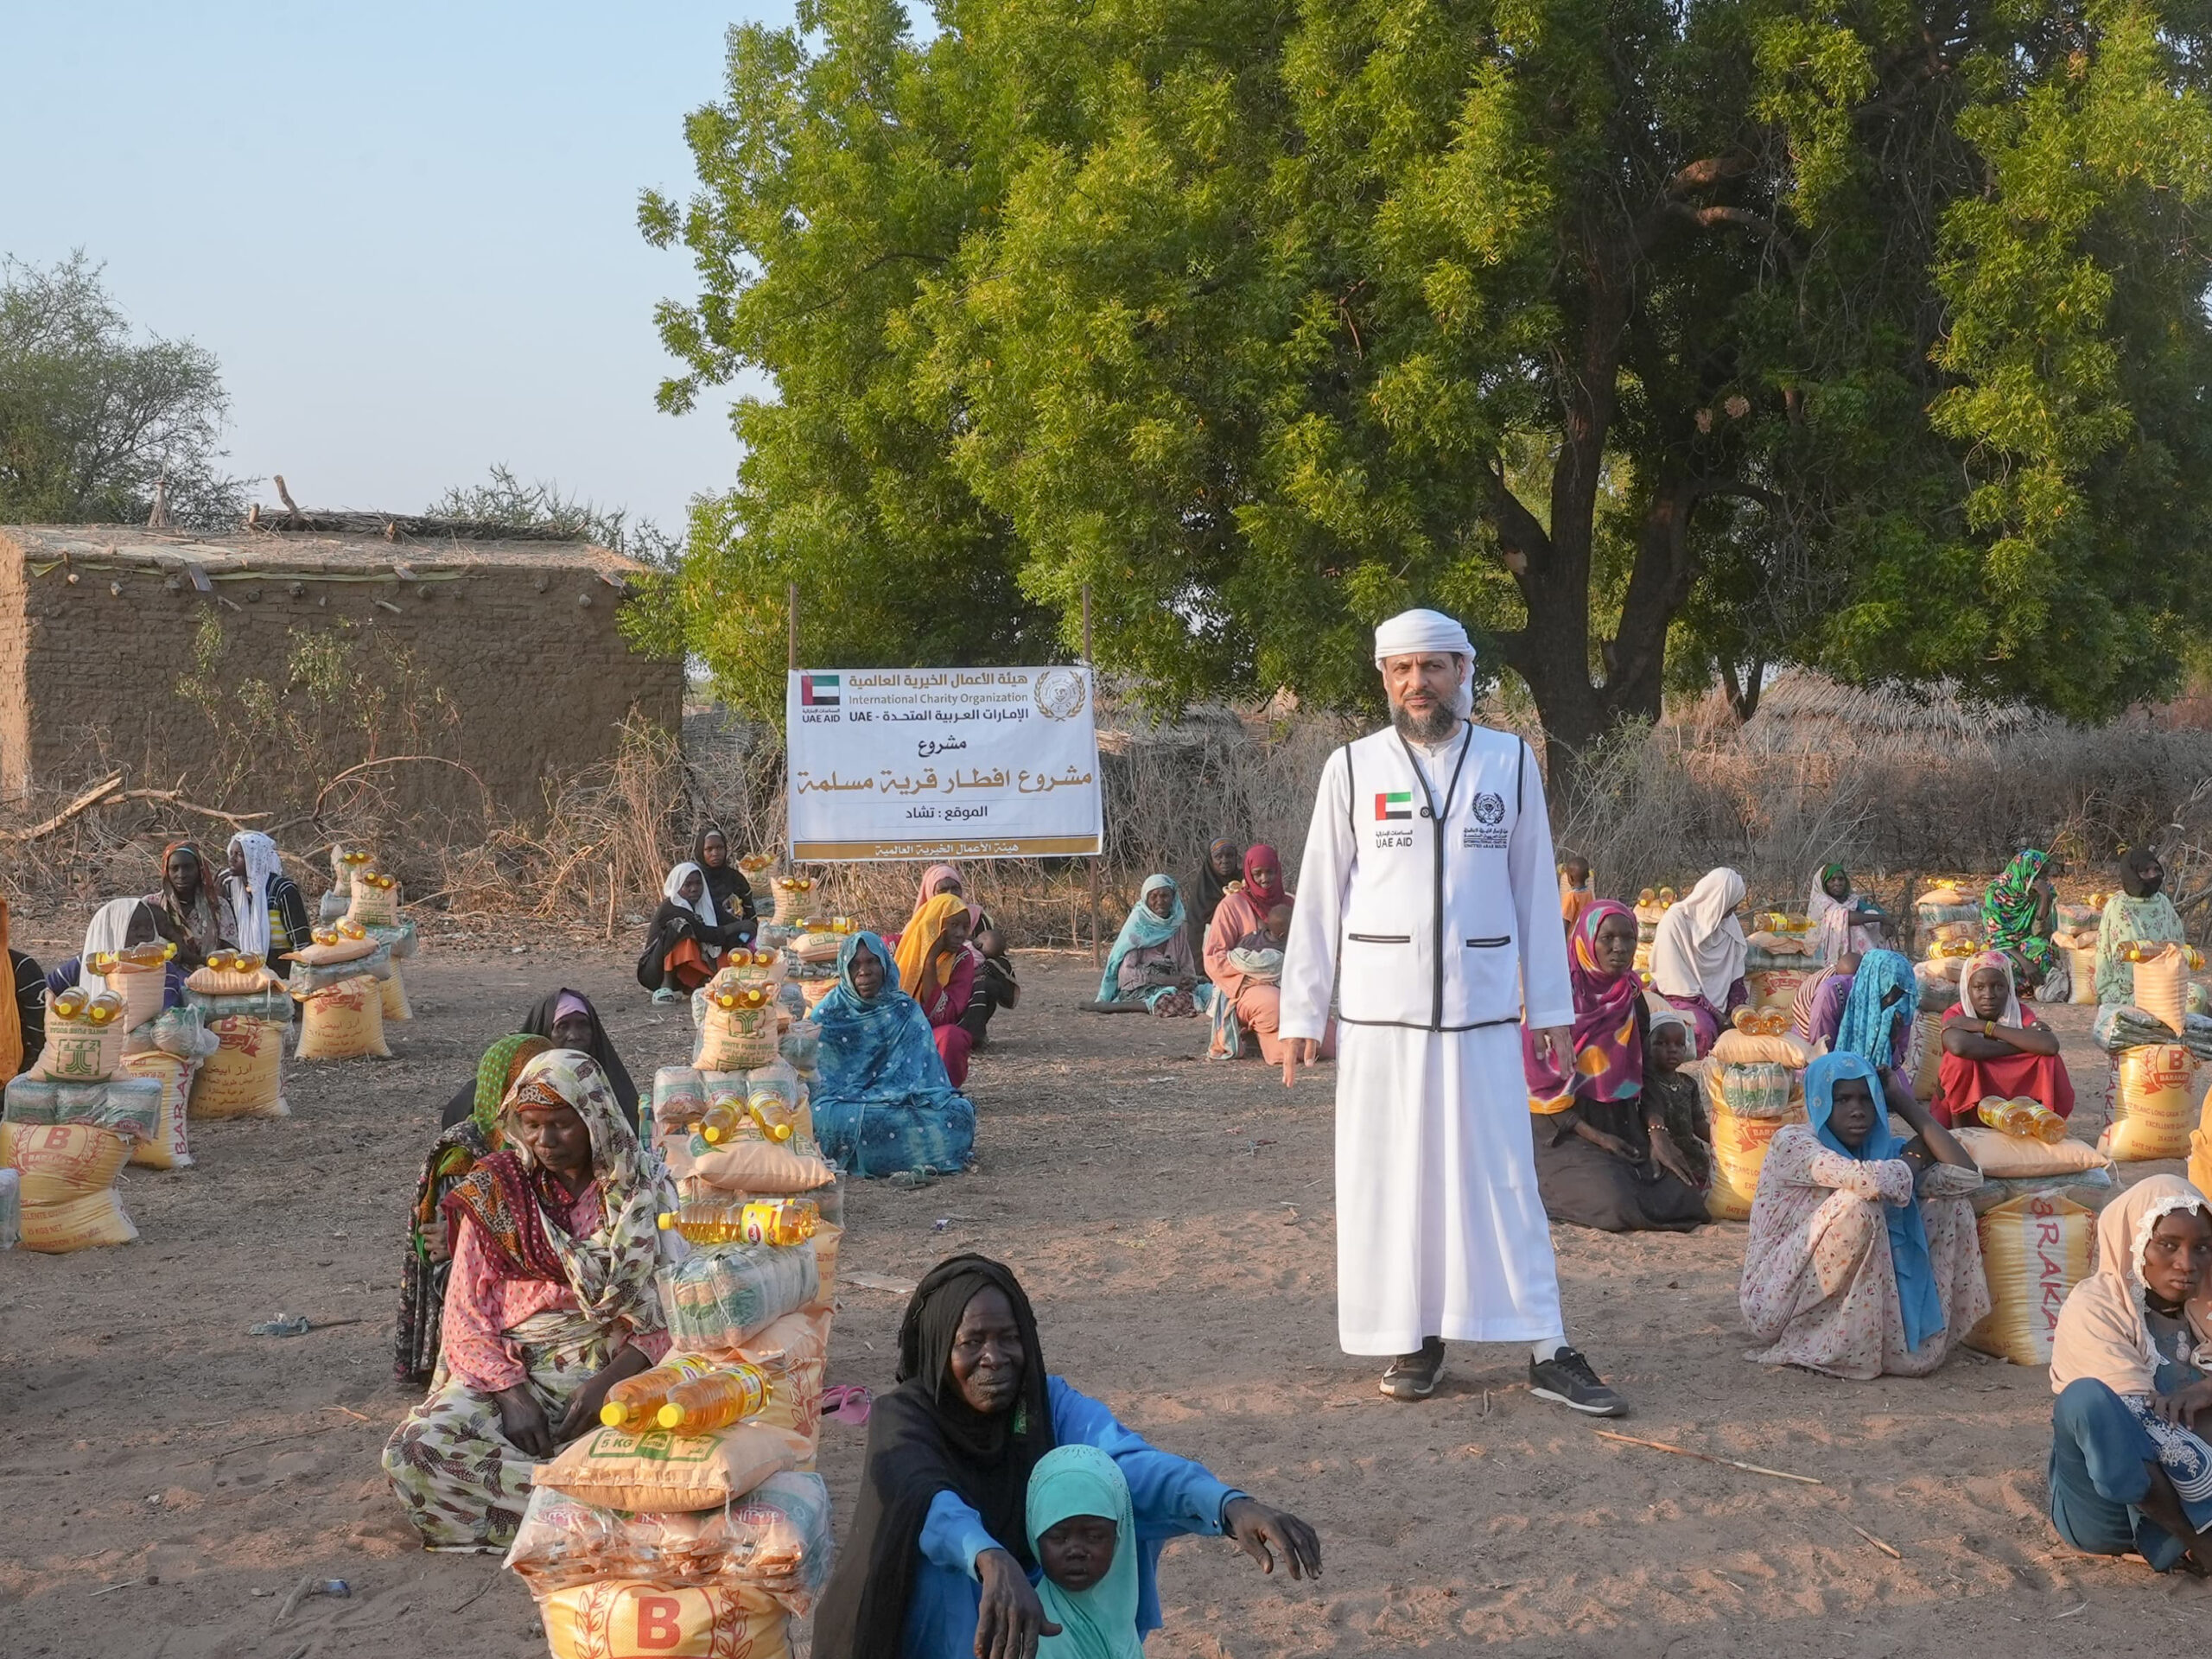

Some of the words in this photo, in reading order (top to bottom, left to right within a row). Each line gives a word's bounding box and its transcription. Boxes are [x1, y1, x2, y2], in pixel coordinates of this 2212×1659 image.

[849, 674, 900, 690] العالمية
[904, 674, 947, 690] الخيرية
[951, 673, 994, 688] الأعمال
[998, 672, 1027, 687] هيئة
[849, 694, 917, 705] International
[920, 694, 958, 705] Charity
[960, 693, 1027, 705] Organization
[803, 715, 822, 723] UAE
[823, 714, 840, 722] AID
[849, 711, 872, 721] UAE
[883, 710, 931, 721] المتحدة
[935, 709, 979, 723] العربية
[918, 735, 967, 758] مشروع
[798, 770, 874, 795] مسلمة
[880, 768, 938, 795] قرية
[940, 767, 1010, 794] افطار
[1018, 765, 1092, 793] مشروع
[906, 805, 935, 819] تشاد
[944, 806, 988, 821] الموقع
[916, 843, 953, 856] الخيرية
[1376, 837, 1393, 848] UAE
[1396, 836, 1413, 847] AID
[875, 845, 913, 856] العالمية
[1961, 924, 1968, 934] B
[2169, 1050, 2184, 1070] B
[174, 1062, 195, 1154] BARAK
[2101, 1055, 2119, 1147] RAKAT
[44, 1127, 72, 1149] B
[601, 1439, 608, 1448] 5
[613, 1438, 633, 1448] KG
[637, 1596, 681, 1649] B
